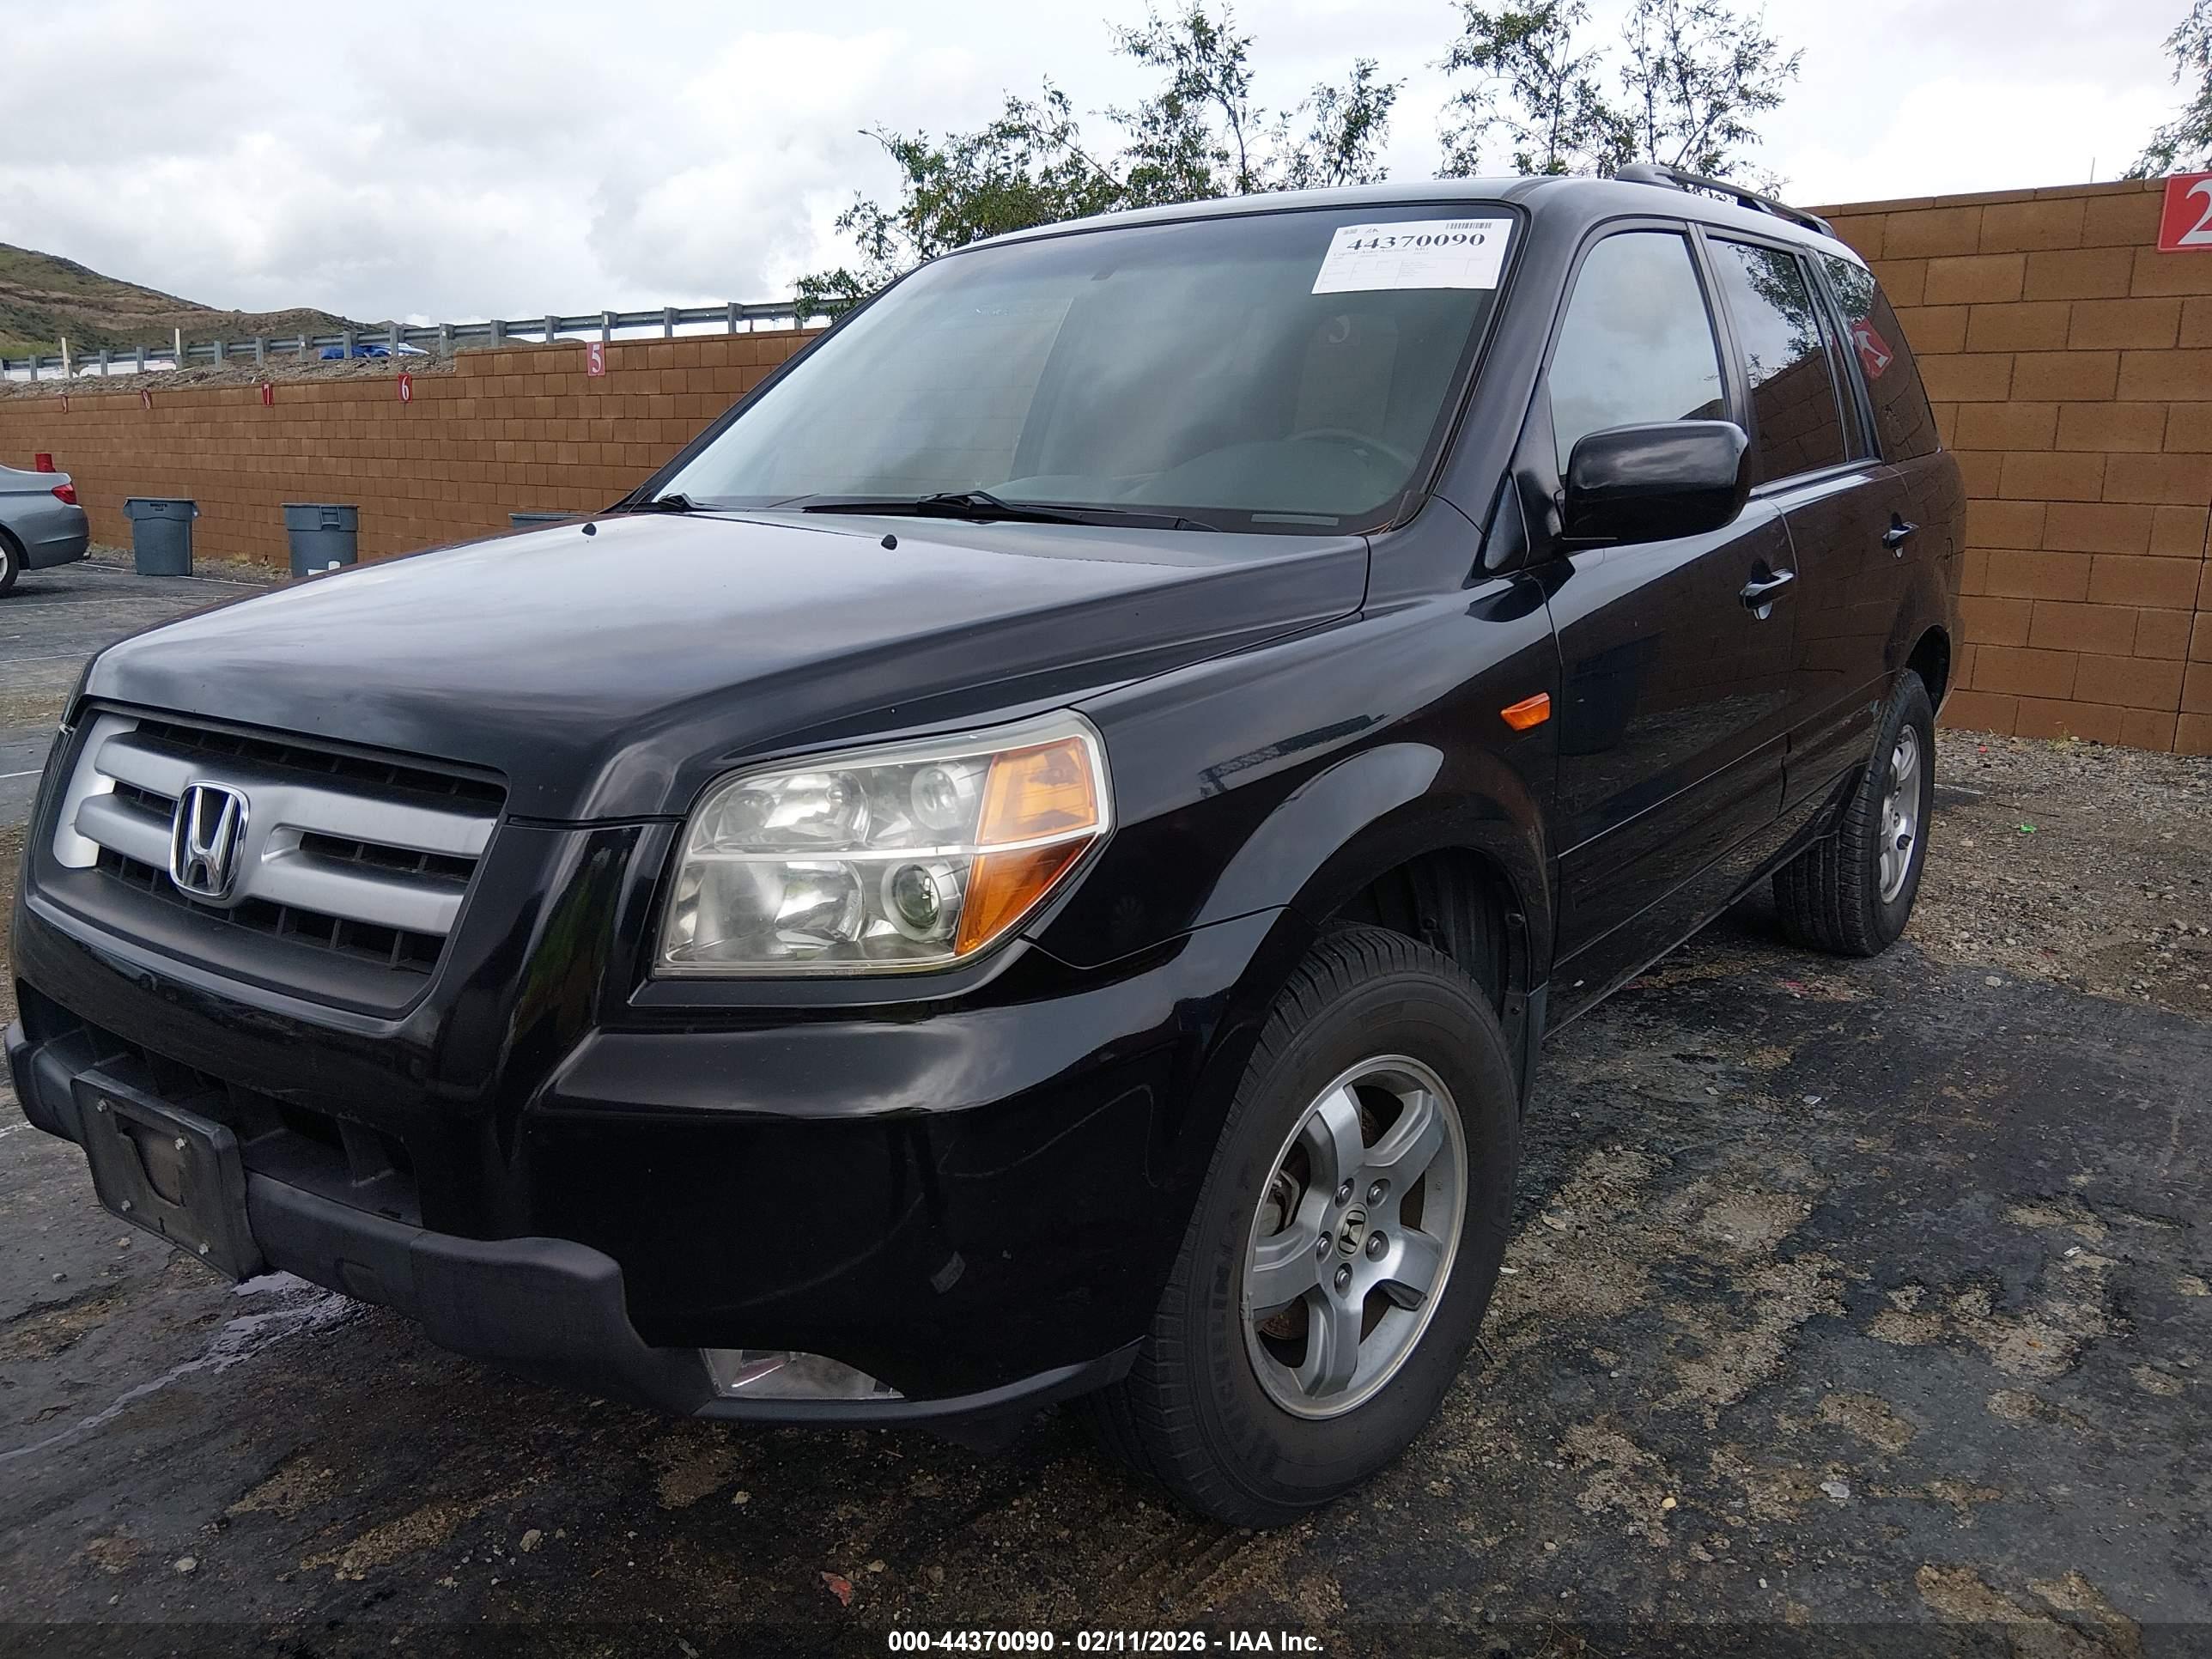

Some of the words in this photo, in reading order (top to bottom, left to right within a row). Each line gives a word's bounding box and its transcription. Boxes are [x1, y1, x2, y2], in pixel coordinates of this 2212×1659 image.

[2177, 179, 2212, 245] 2
[1346, 233, 1486, 252] 44370090
[592, 343, 602, 374] 5
[264, 383, 270, 405] 7
[401, 375, 410, 401] 6
[143, 391, 150, 410] 8
